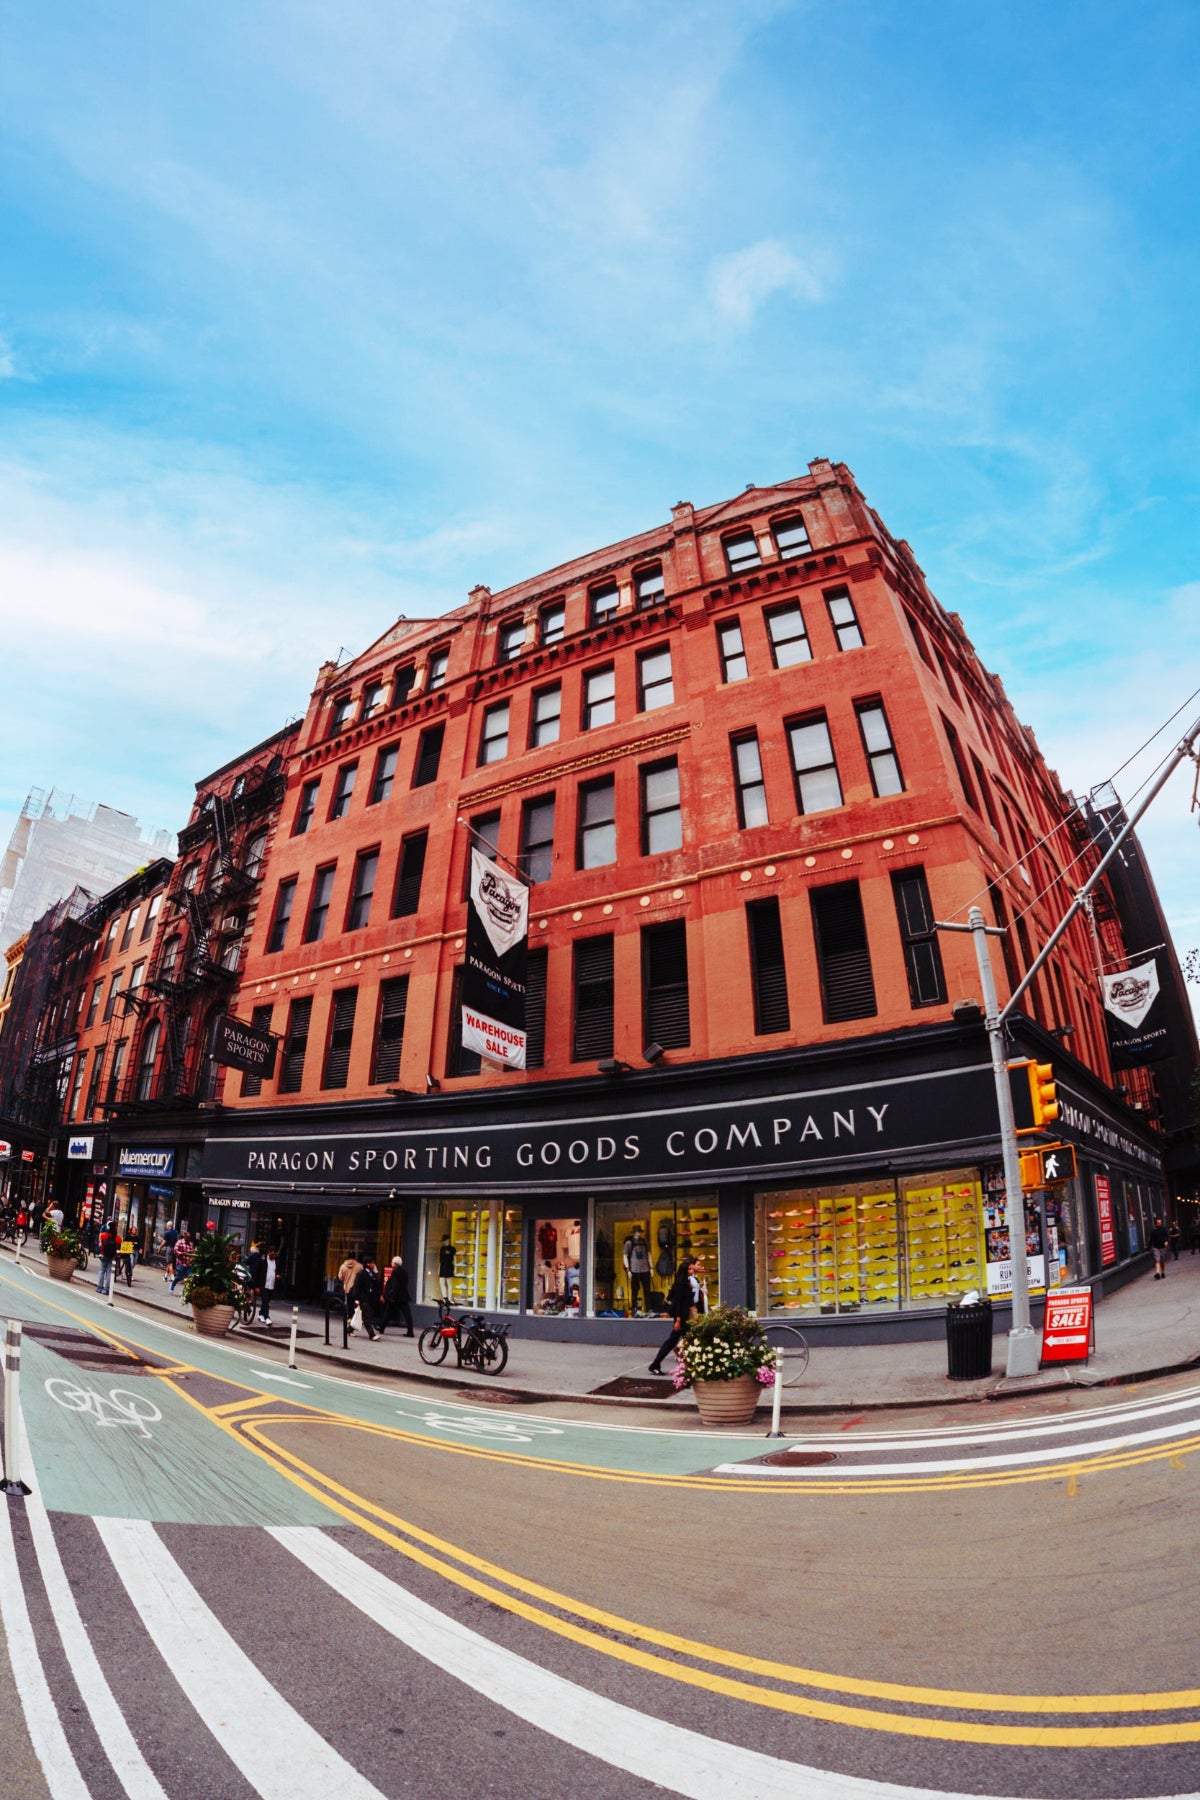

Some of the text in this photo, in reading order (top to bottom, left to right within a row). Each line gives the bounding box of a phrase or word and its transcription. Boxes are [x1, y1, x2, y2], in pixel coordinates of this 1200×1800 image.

[481, 872, 521, 914] Paragon
[469, 955, 501, 982] PARAGON
[1111, 980, 1150, 999] Paragon
[224, 1027, 271, 1054] PARAGON
[466, 1013, 525, 1048] WAREHOUSE
[226, 1041, 265, 1064] SPORTS
[485, 1038, 509, 1058] SALE
[248, 1104, 889, 1171] PARAGON SPORTING GOODS COMPANY
[119, 1148, 171, 1171] bluemercury
[208, 1197, 251, 1209] PARAGON SPORTS
[1071, 1297, 1088, 1305] SPORTS
[1051, 1312, 1084, 1328] SALE
